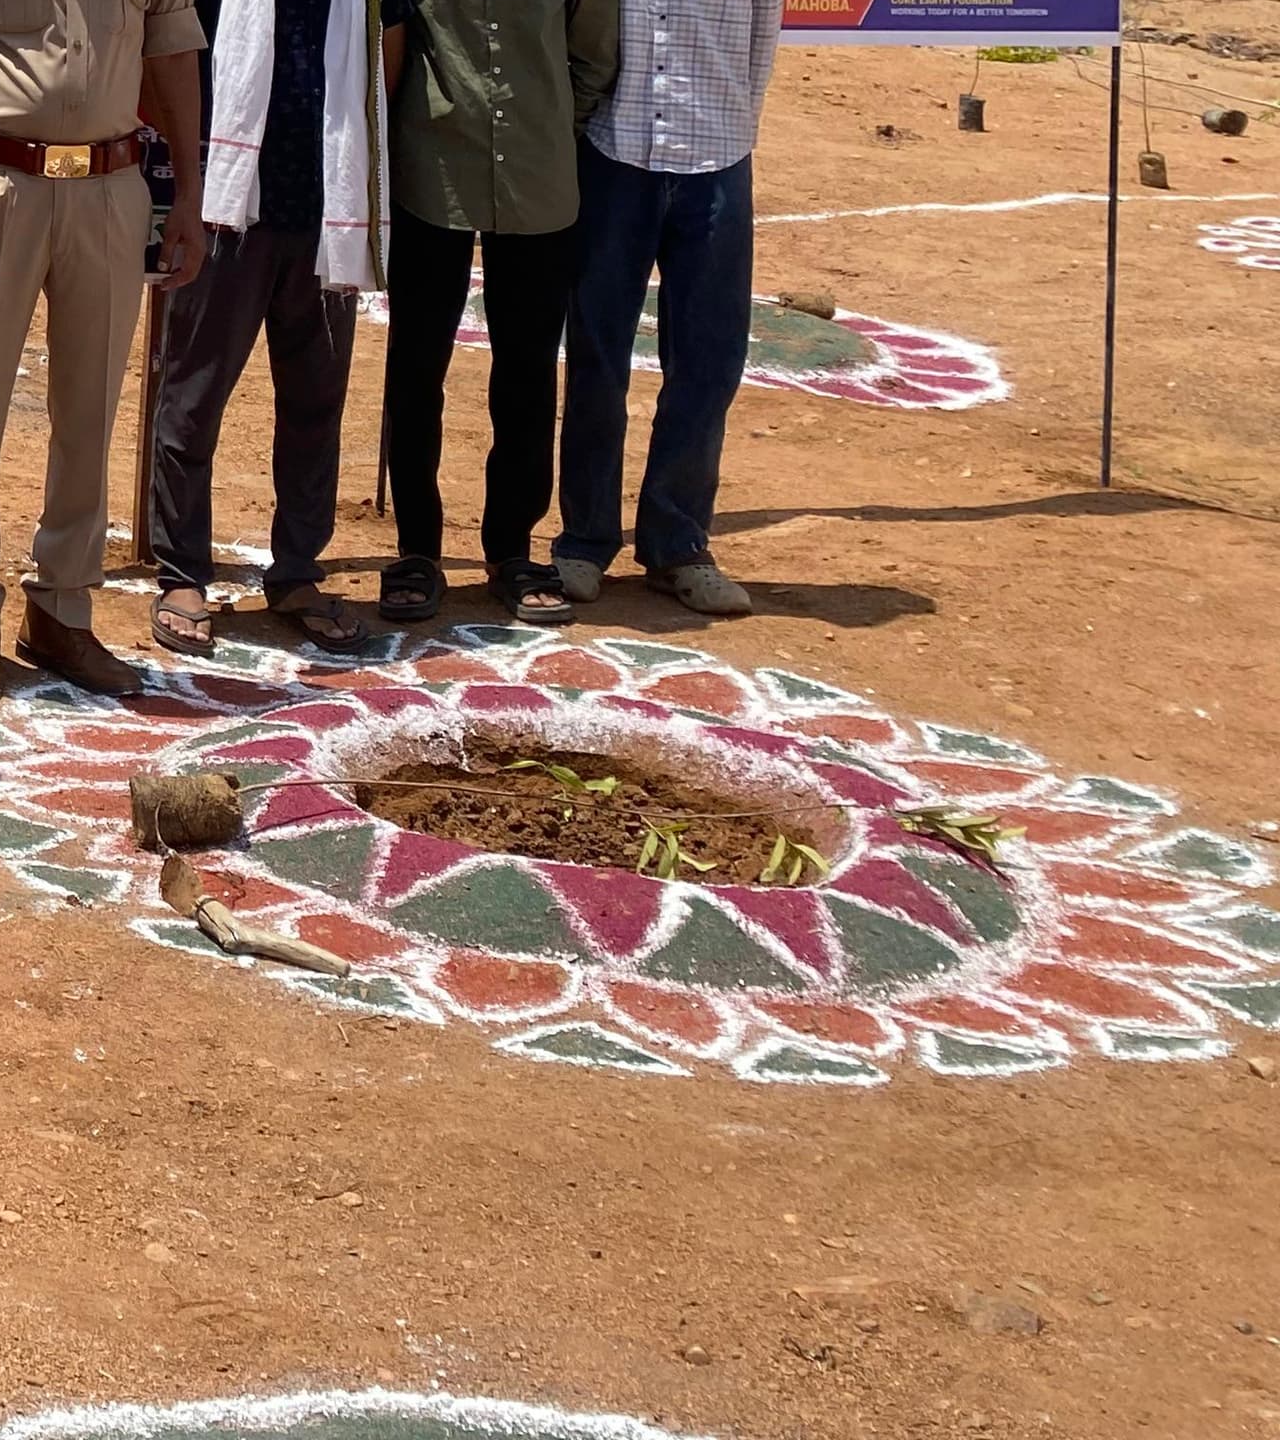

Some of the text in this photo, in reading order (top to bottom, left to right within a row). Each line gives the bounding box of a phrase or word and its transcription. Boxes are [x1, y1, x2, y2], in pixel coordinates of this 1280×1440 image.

[890, 7, 1049, 17] WORKING TODAY FOR A BETTER TOMORROW
